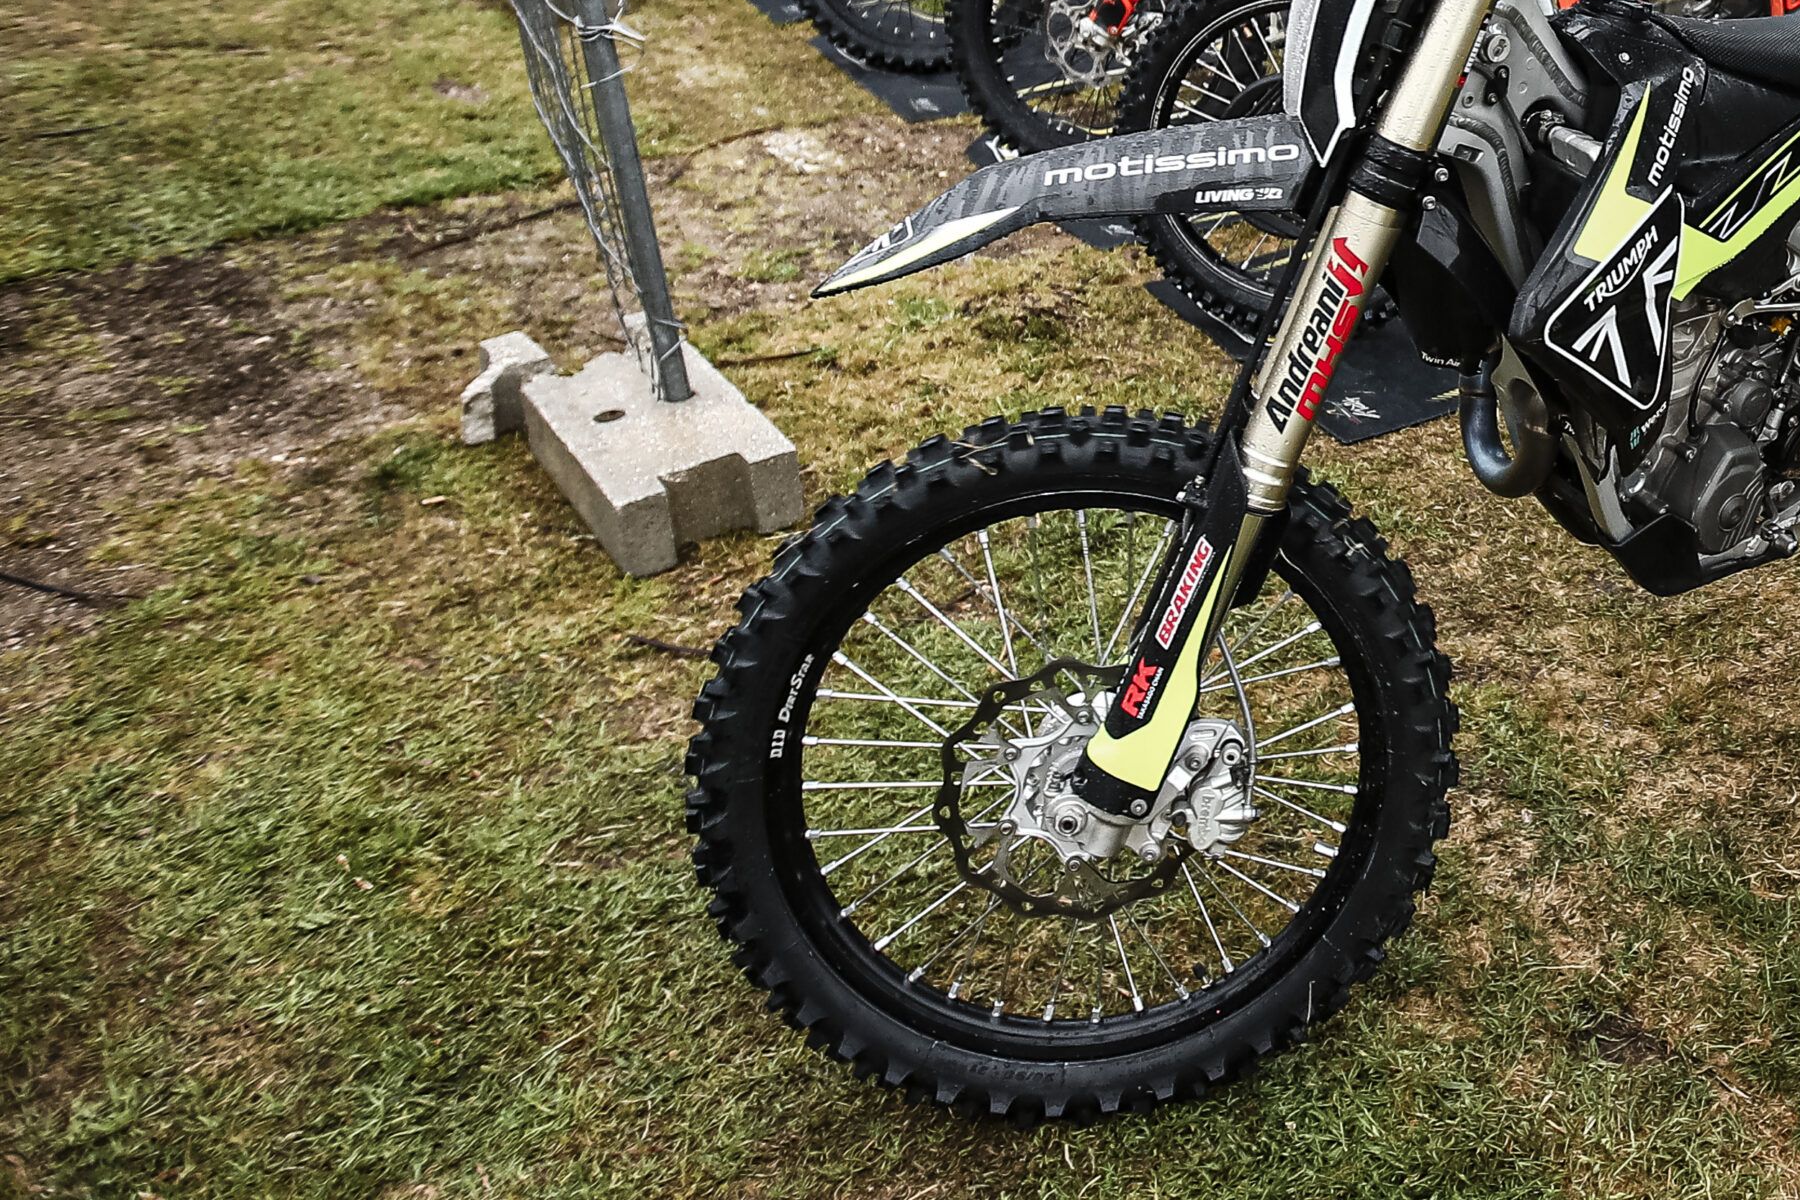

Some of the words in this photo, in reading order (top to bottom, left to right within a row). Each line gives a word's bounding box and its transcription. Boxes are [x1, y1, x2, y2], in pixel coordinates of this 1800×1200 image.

[1646, 65, 1696, 188] motissimo
[1043, 144, 1300, 186] motissimo
[1194, 187, 1255, 204] LIVING
[1583, 224, 1660, 312] TRIUMPH
[1264, 270, 1346, 436] Andreani
[1420, 351, 1445, 366] Twin
[1445, 358, 1461, 368] Air
[1157, 540, 1211, 648] BRAKING
[1120, 656, 1160, 719] RK
